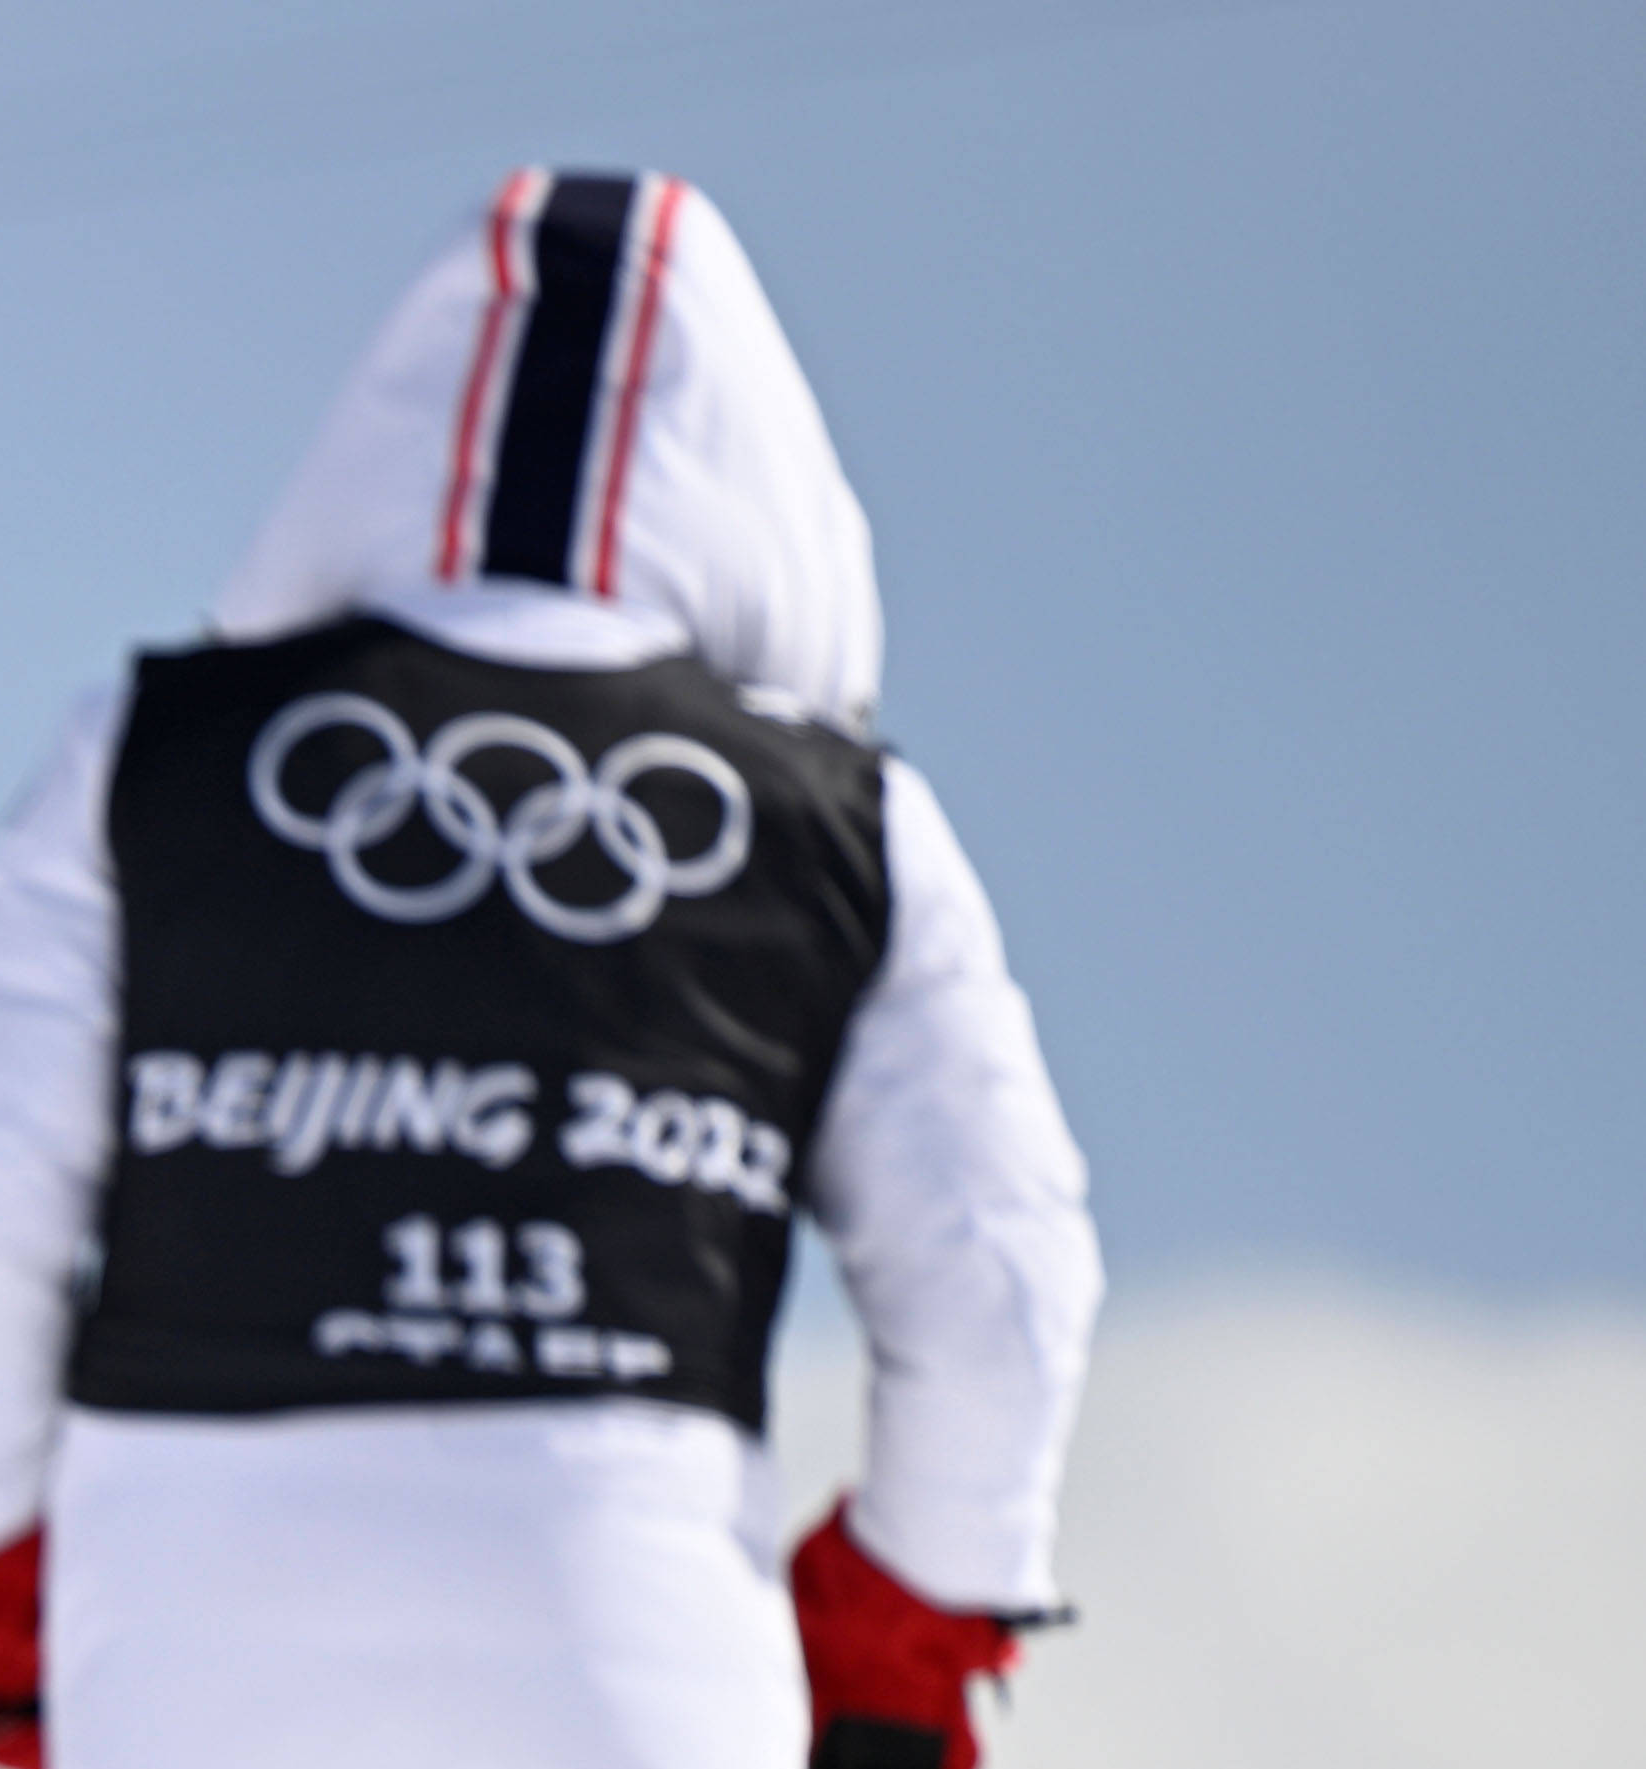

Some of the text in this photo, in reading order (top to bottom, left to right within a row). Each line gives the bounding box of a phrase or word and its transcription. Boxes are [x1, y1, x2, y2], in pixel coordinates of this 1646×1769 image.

[129, 1052, 790, 1212] BEIJING 2022
[385, 1215, 586, 1318] 113
